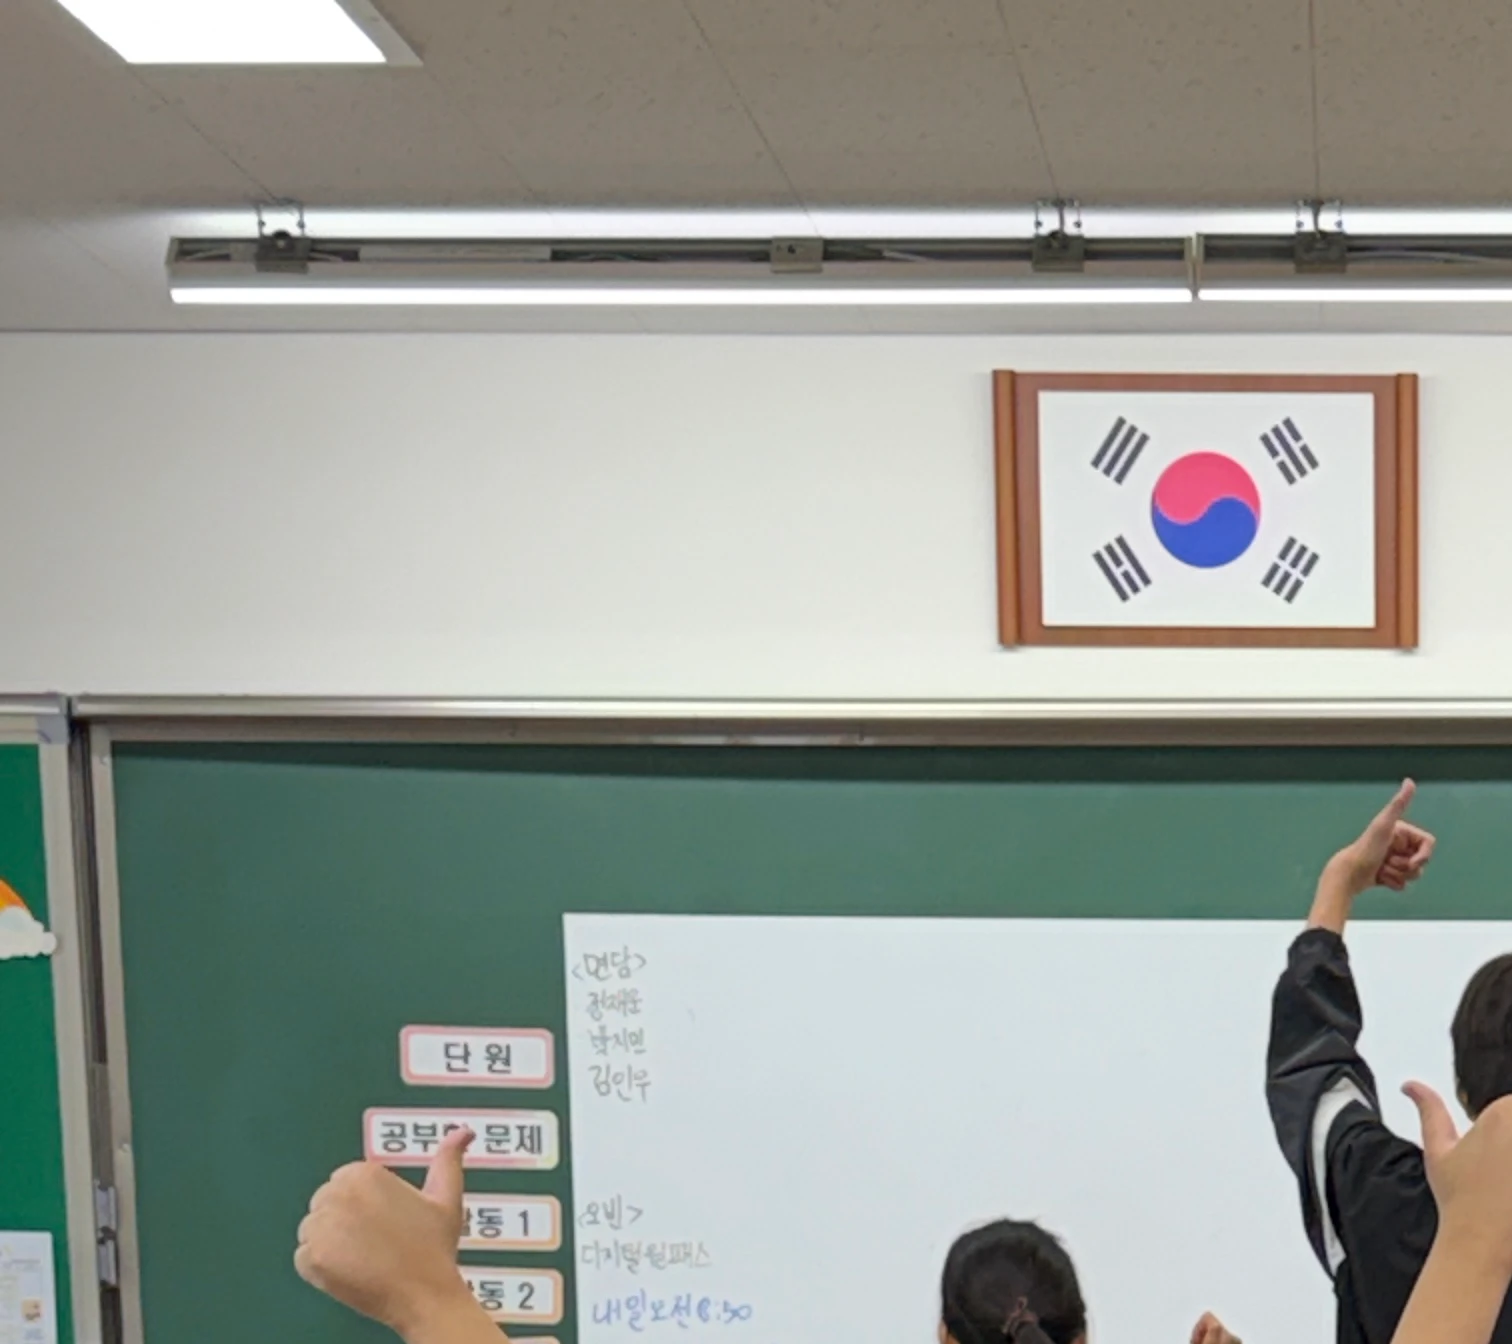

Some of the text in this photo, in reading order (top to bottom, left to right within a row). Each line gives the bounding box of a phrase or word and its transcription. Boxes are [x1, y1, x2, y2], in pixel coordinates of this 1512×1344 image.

[379, 1121, 543, 1155] 공부 문제
[518, 1209, 530, 1237] 1
[518, 1281, 535, 1311] 2
